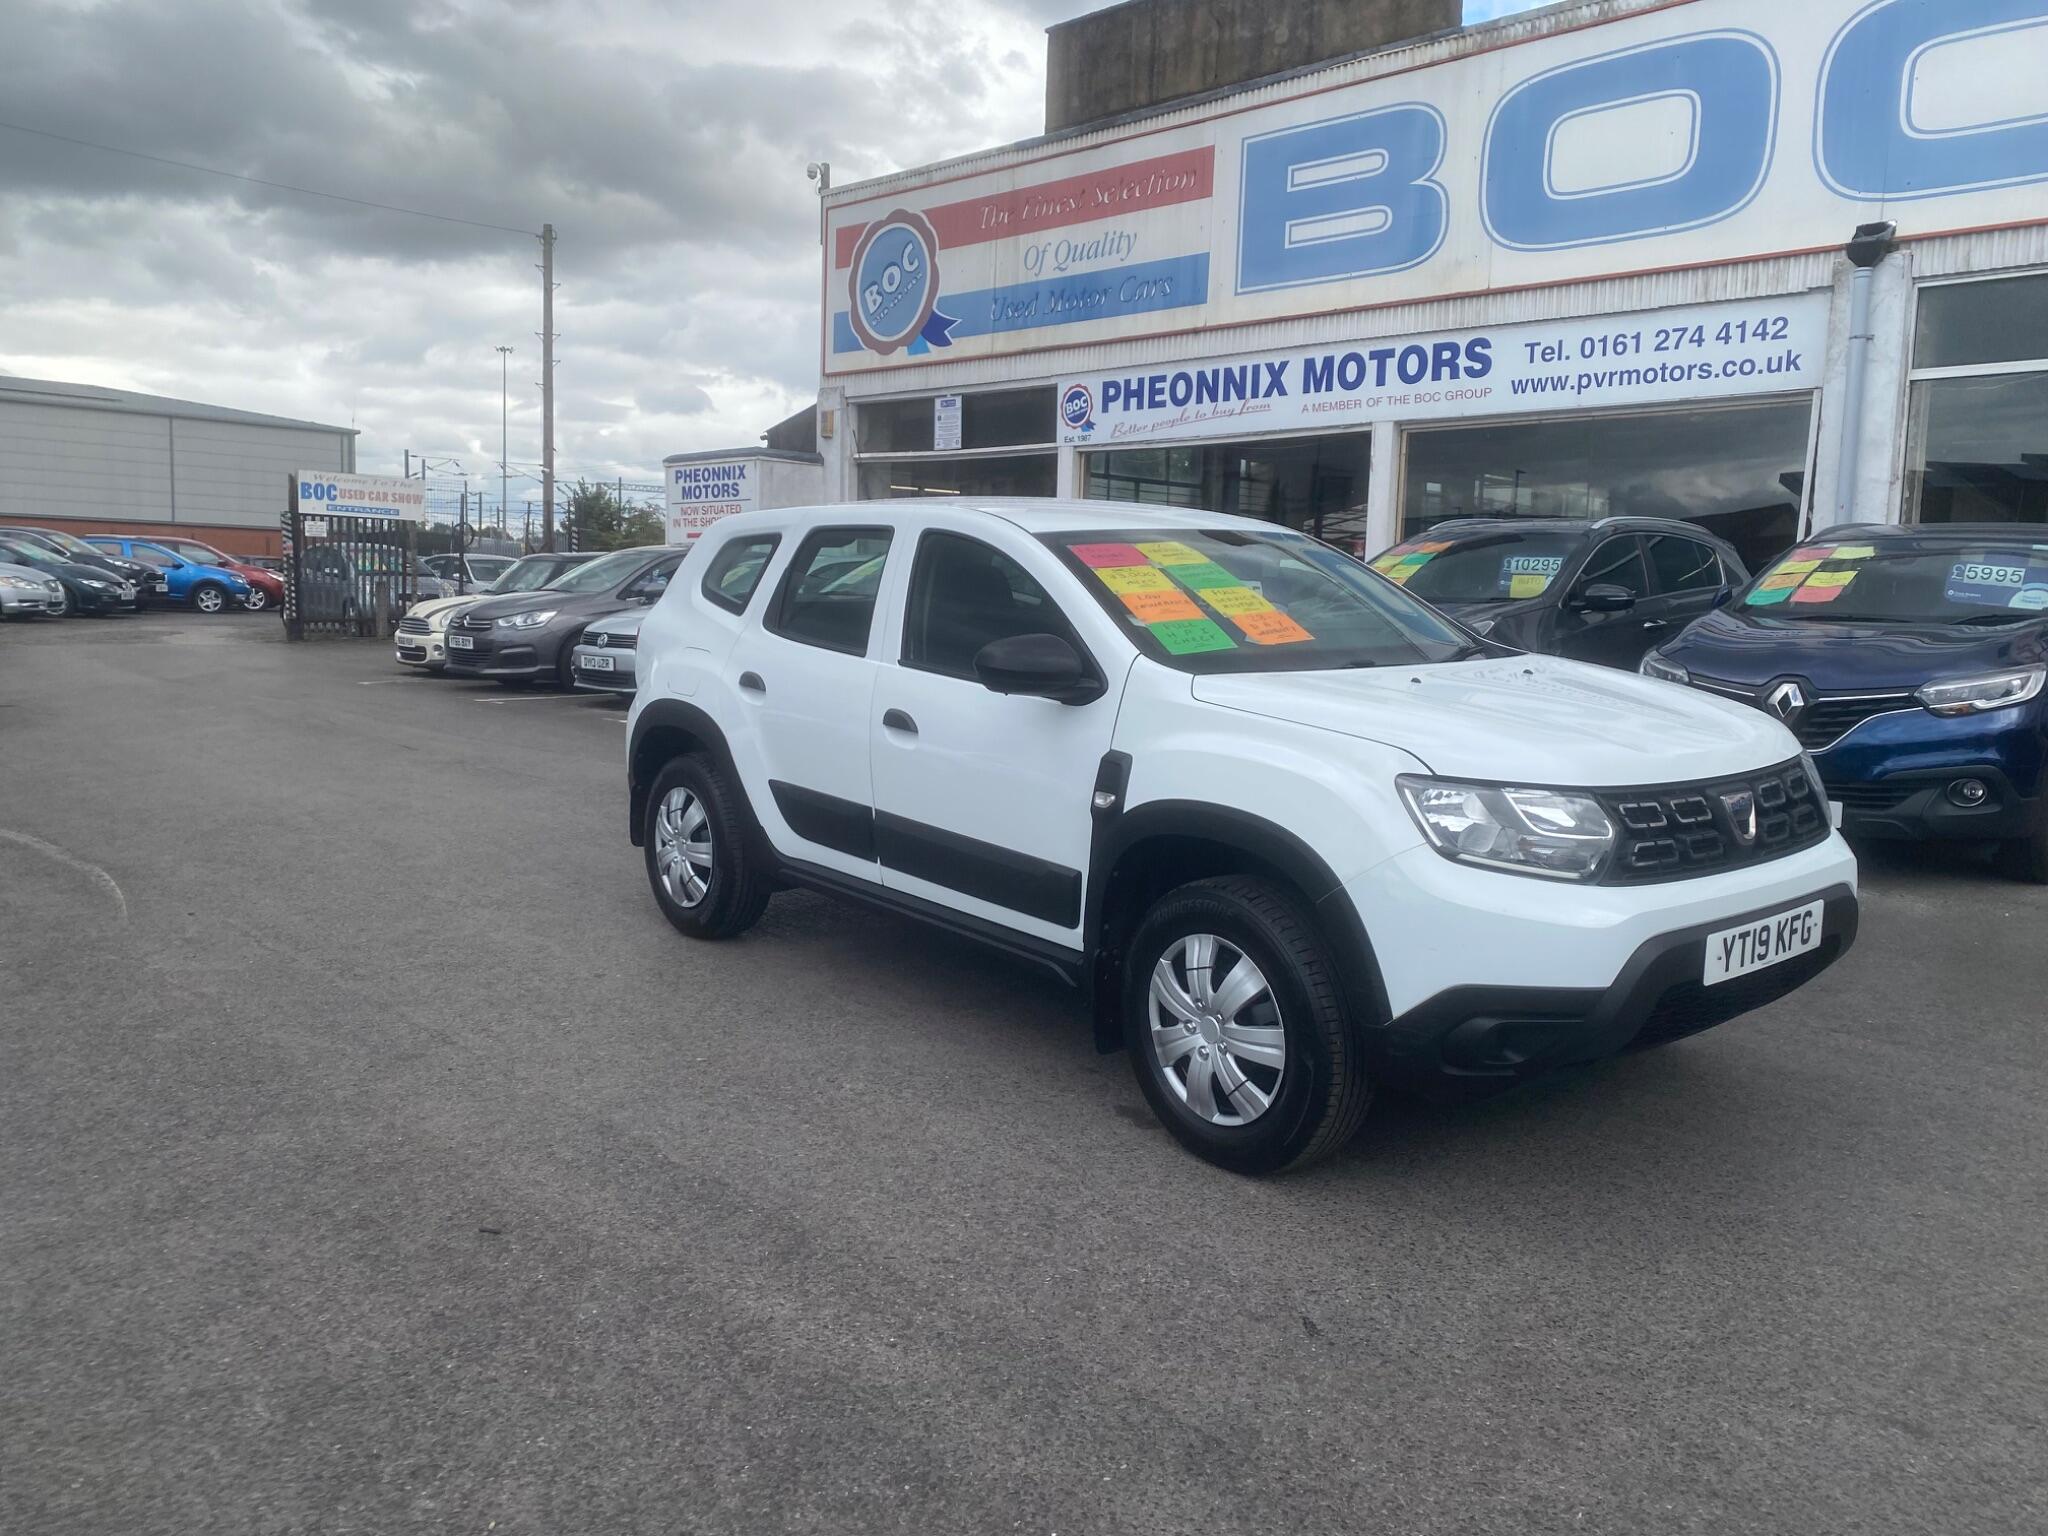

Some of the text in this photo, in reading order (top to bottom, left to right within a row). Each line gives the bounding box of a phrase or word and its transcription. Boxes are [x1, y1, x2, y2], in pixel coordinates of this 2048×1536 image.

[1091, 168, 1198, 207] Selection
[1023, 230, 1138, 277] Of Quality
[864, 242, 920, 315] BOC
[990, 274, 1175, 322] Used Motor Cars
[1524, 316, 1790, 364] Tel. 0161 274 4142
[1101, 336, 1493, 414] PHEONNIX MOTORS
[1510, 349, 1803, 395] www.pvrmotors.co.uk
[1065, 396, 1088, 414] BOC
[1301, 387, 1493, 414] A MEMBER OF THE BOC GROUP
[1110, 421, 1148, 438] Better
[1151, 408, 1191, 432] people
[1194, 409, 1207, 419] to
[675, 465, 746, 484] PHEONNIX
[300, 482, 338, 501] BOC
[339, 488, 365, 500] USED
[368, 490, 389, 503] CAR
[681, 482, 740, 500] MOTORS
[327, 505, 399, 515] ENTRANCE
[680, 504, 742, 516] NOW SITUATED
[683, 518, 698, 527] THE
[1951, 563, 2024, 583] £5995
[1722, 909, 1814, 973] YT19 KFG
